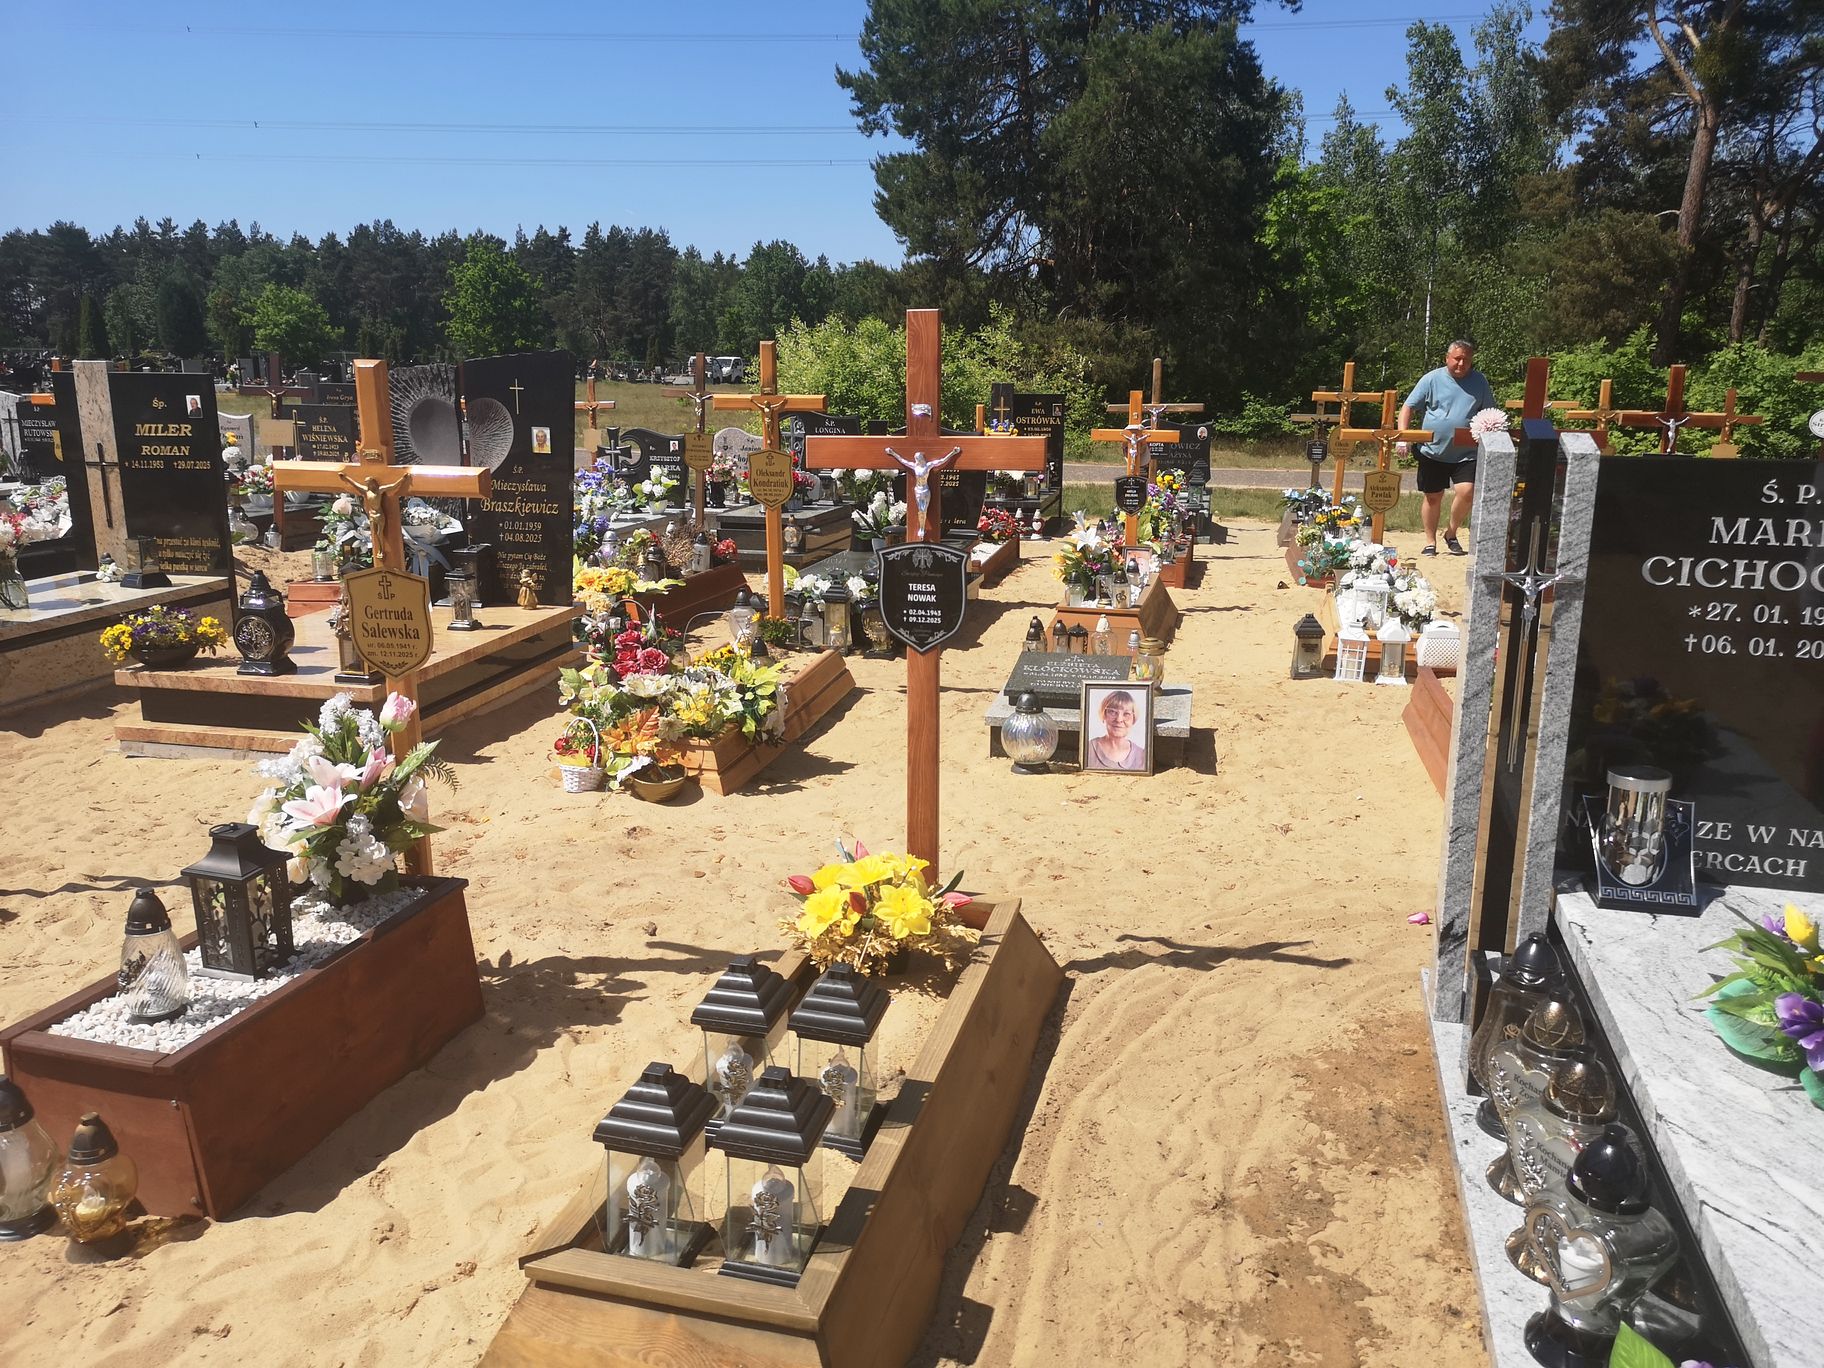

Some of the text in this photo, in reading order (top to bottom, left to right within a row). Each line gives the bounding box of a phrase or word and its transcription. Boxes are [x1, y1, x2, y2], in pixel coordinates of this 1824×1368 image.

[1015, 415, 1061, 425] OSTRÓWKA
[134, 423, 192, 437] MILER
[312, 425, 337, 433] HELENA
[815, 426, 846, 434] LONGINA
[302, 433, 348, 443] WIŚNIEWSKA
[141, 445, 190, 456] ROMAN
[491, 480, 546, 495] Mieczysława
[753, 478, 788, 489] Kondratiuk
[1760, 479, 1822, 505] Ś. P.
[480, 497, 559, 517] Braszkiewicz
[504, 521, 542, 531] 01.01.1959
[908, 583, 936, 592] TERESA
[907, 593, 937, 603] NOWAK
[364, 604, 414, 620] Gertruda
[1753, 604, 1789, 625] 01.
[908, 616, 942, 624] 09.12.2025
[361, 621, 420, 640] Salewska
[1748, 637, 1784, 657] 01.
[1746, 824, 1777, 845] W
